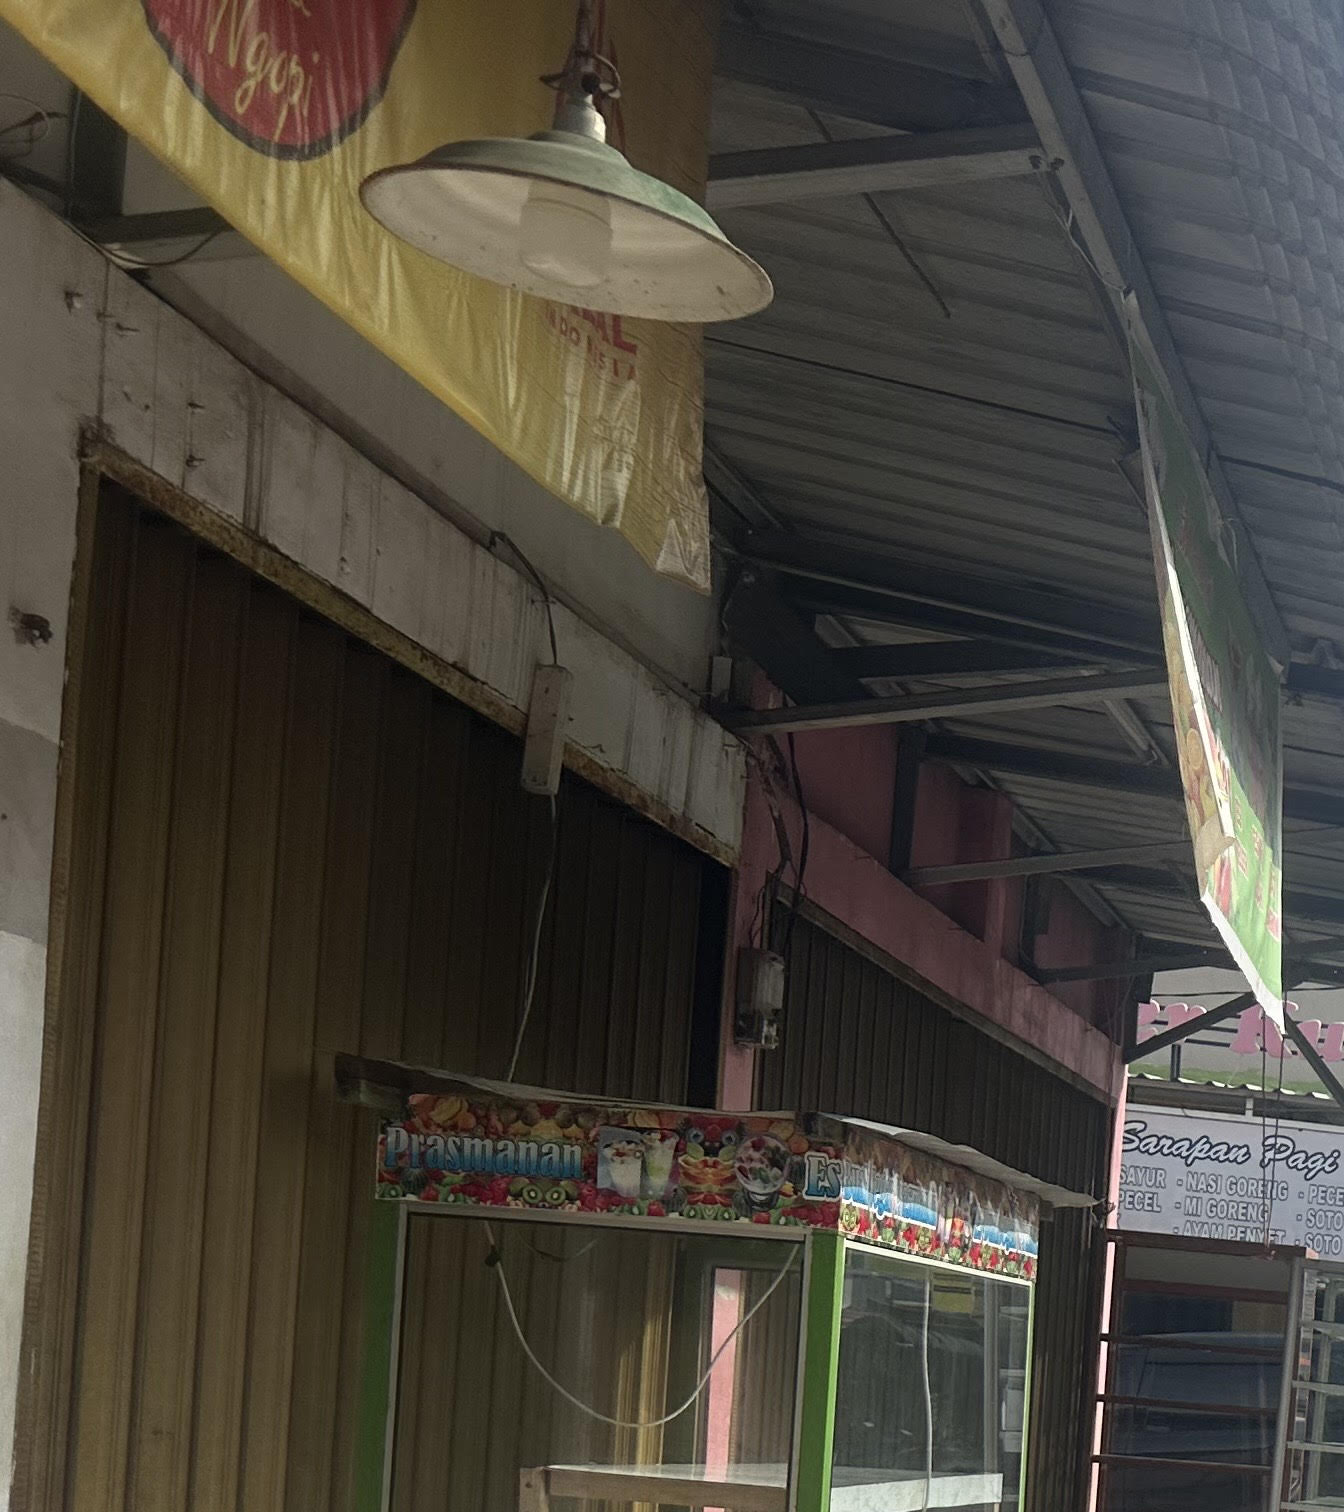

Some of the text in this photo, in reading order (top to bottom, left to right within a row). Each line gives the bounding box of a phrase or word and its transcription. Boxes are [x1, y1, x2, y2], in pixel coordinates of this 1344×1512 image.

[384, 1126, 584, 1178] Prasmanan
[1122, 1120, 1341, 1181] Sarapan Pagi
[804, 1151, 841, 1201] Es
[1186, 1172, 1222, 1195] NASI
[1226, 1175, 1289, 1201] GORENG
[1184, 1198, 1203, 1217] MI
[1206, 1201, 1270, 1223] GORENG
[1306, 1208, 1344, 1232] SOTO
[1182, 1221, 1225, 1240] AYAM
[1305, 1232, 1342, 1256] SOTO
